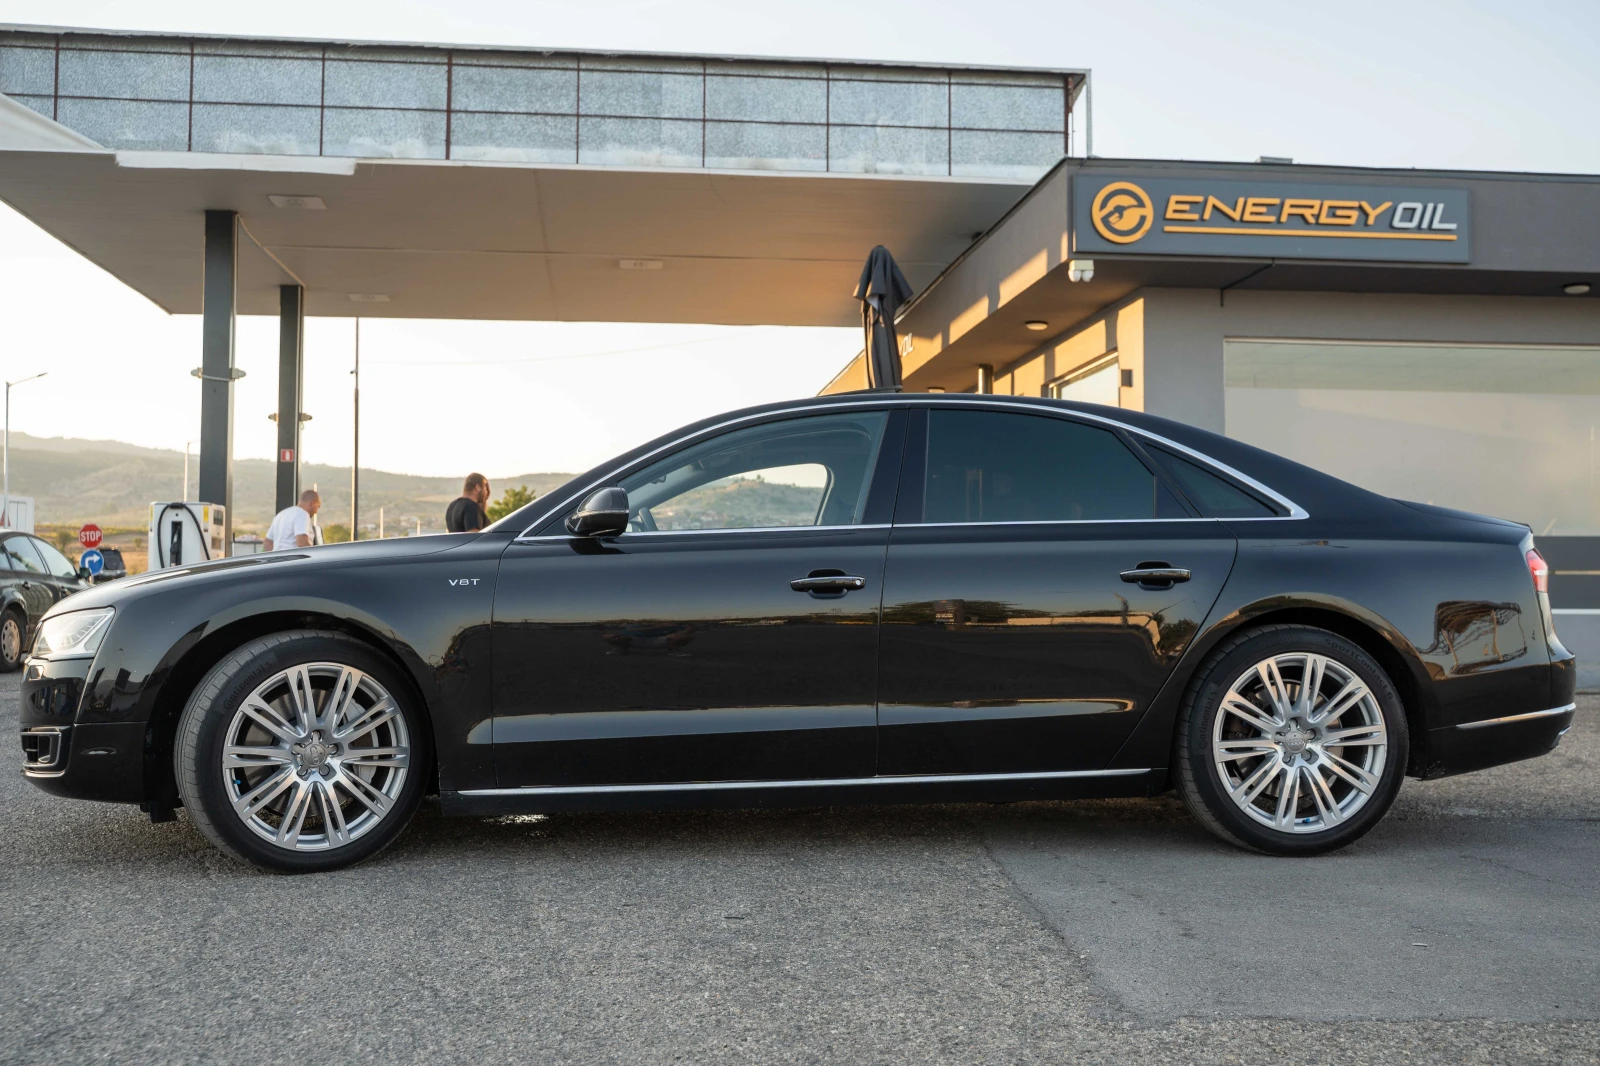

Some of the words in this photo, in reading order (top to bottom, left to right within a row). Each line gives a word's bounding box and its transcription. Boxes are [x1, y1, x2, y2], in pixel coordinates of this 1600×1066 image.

[1164, 194, 1393, 226] ENERGY
[80, 531, 101, 542] STOP
[448, 578, 480, 586] V8T
[1324, 638, 1388, 690] SportContact
[223, 664, 267, 710] Continental
[1198, 697, 1215, 749] Continental
